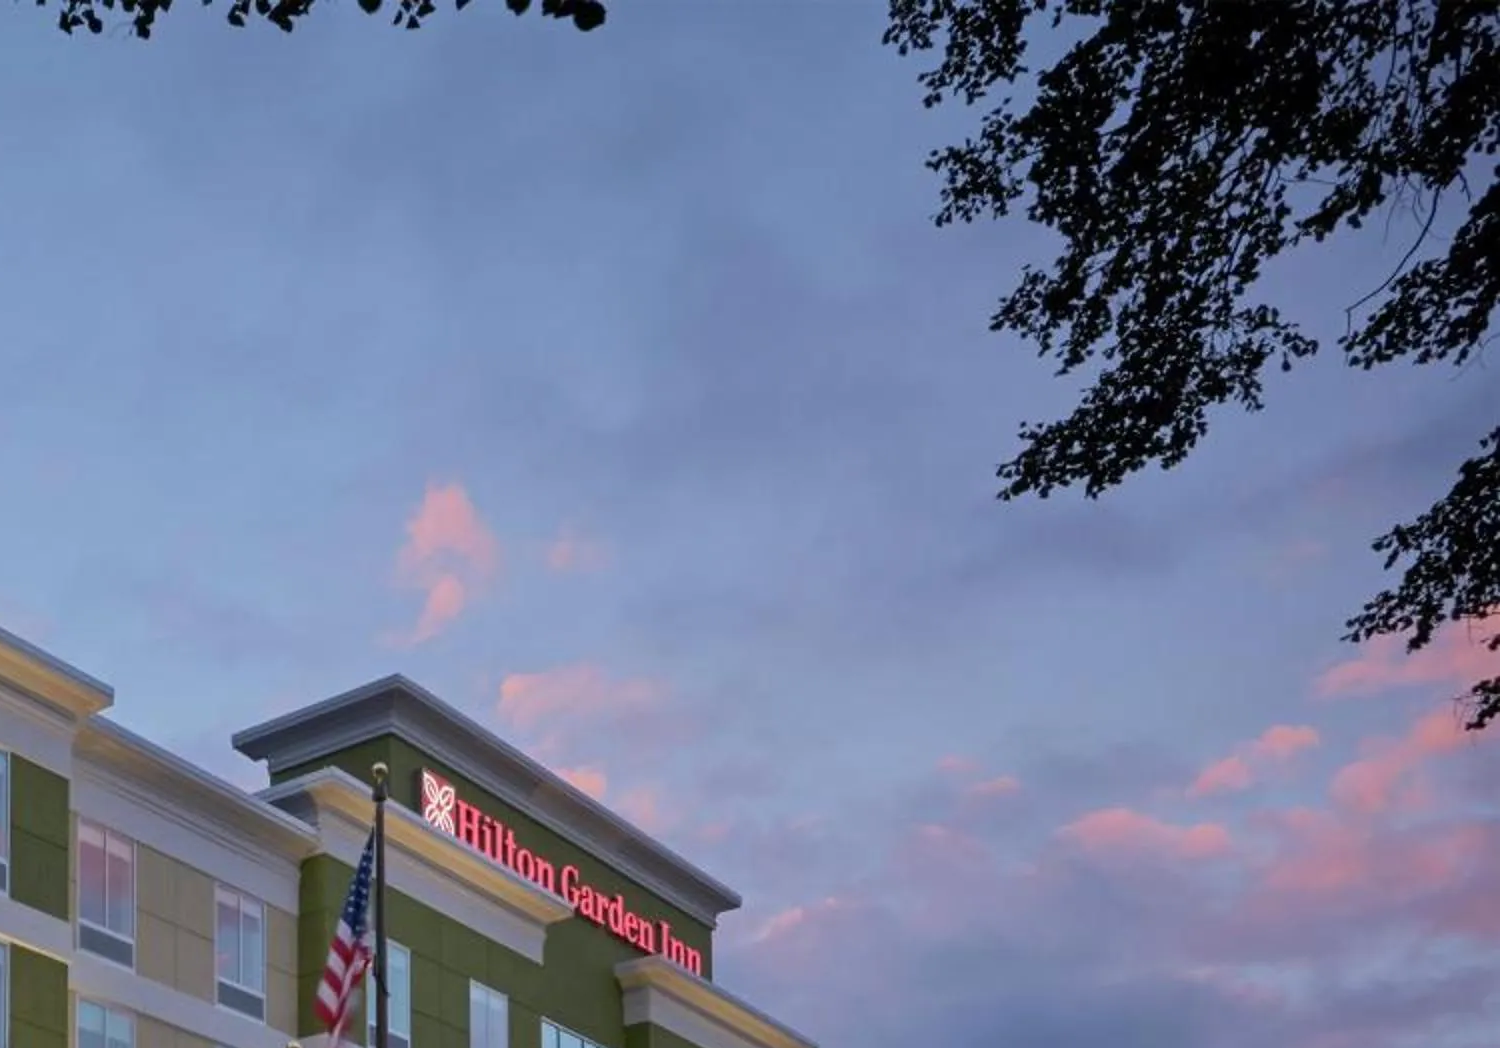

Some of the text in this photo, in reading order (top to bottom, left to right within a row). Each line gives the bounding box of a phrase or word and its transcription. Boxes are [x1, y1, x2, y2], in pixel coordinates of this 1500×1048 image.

[457, 799, 702, 977] Hilton Garden Inn
